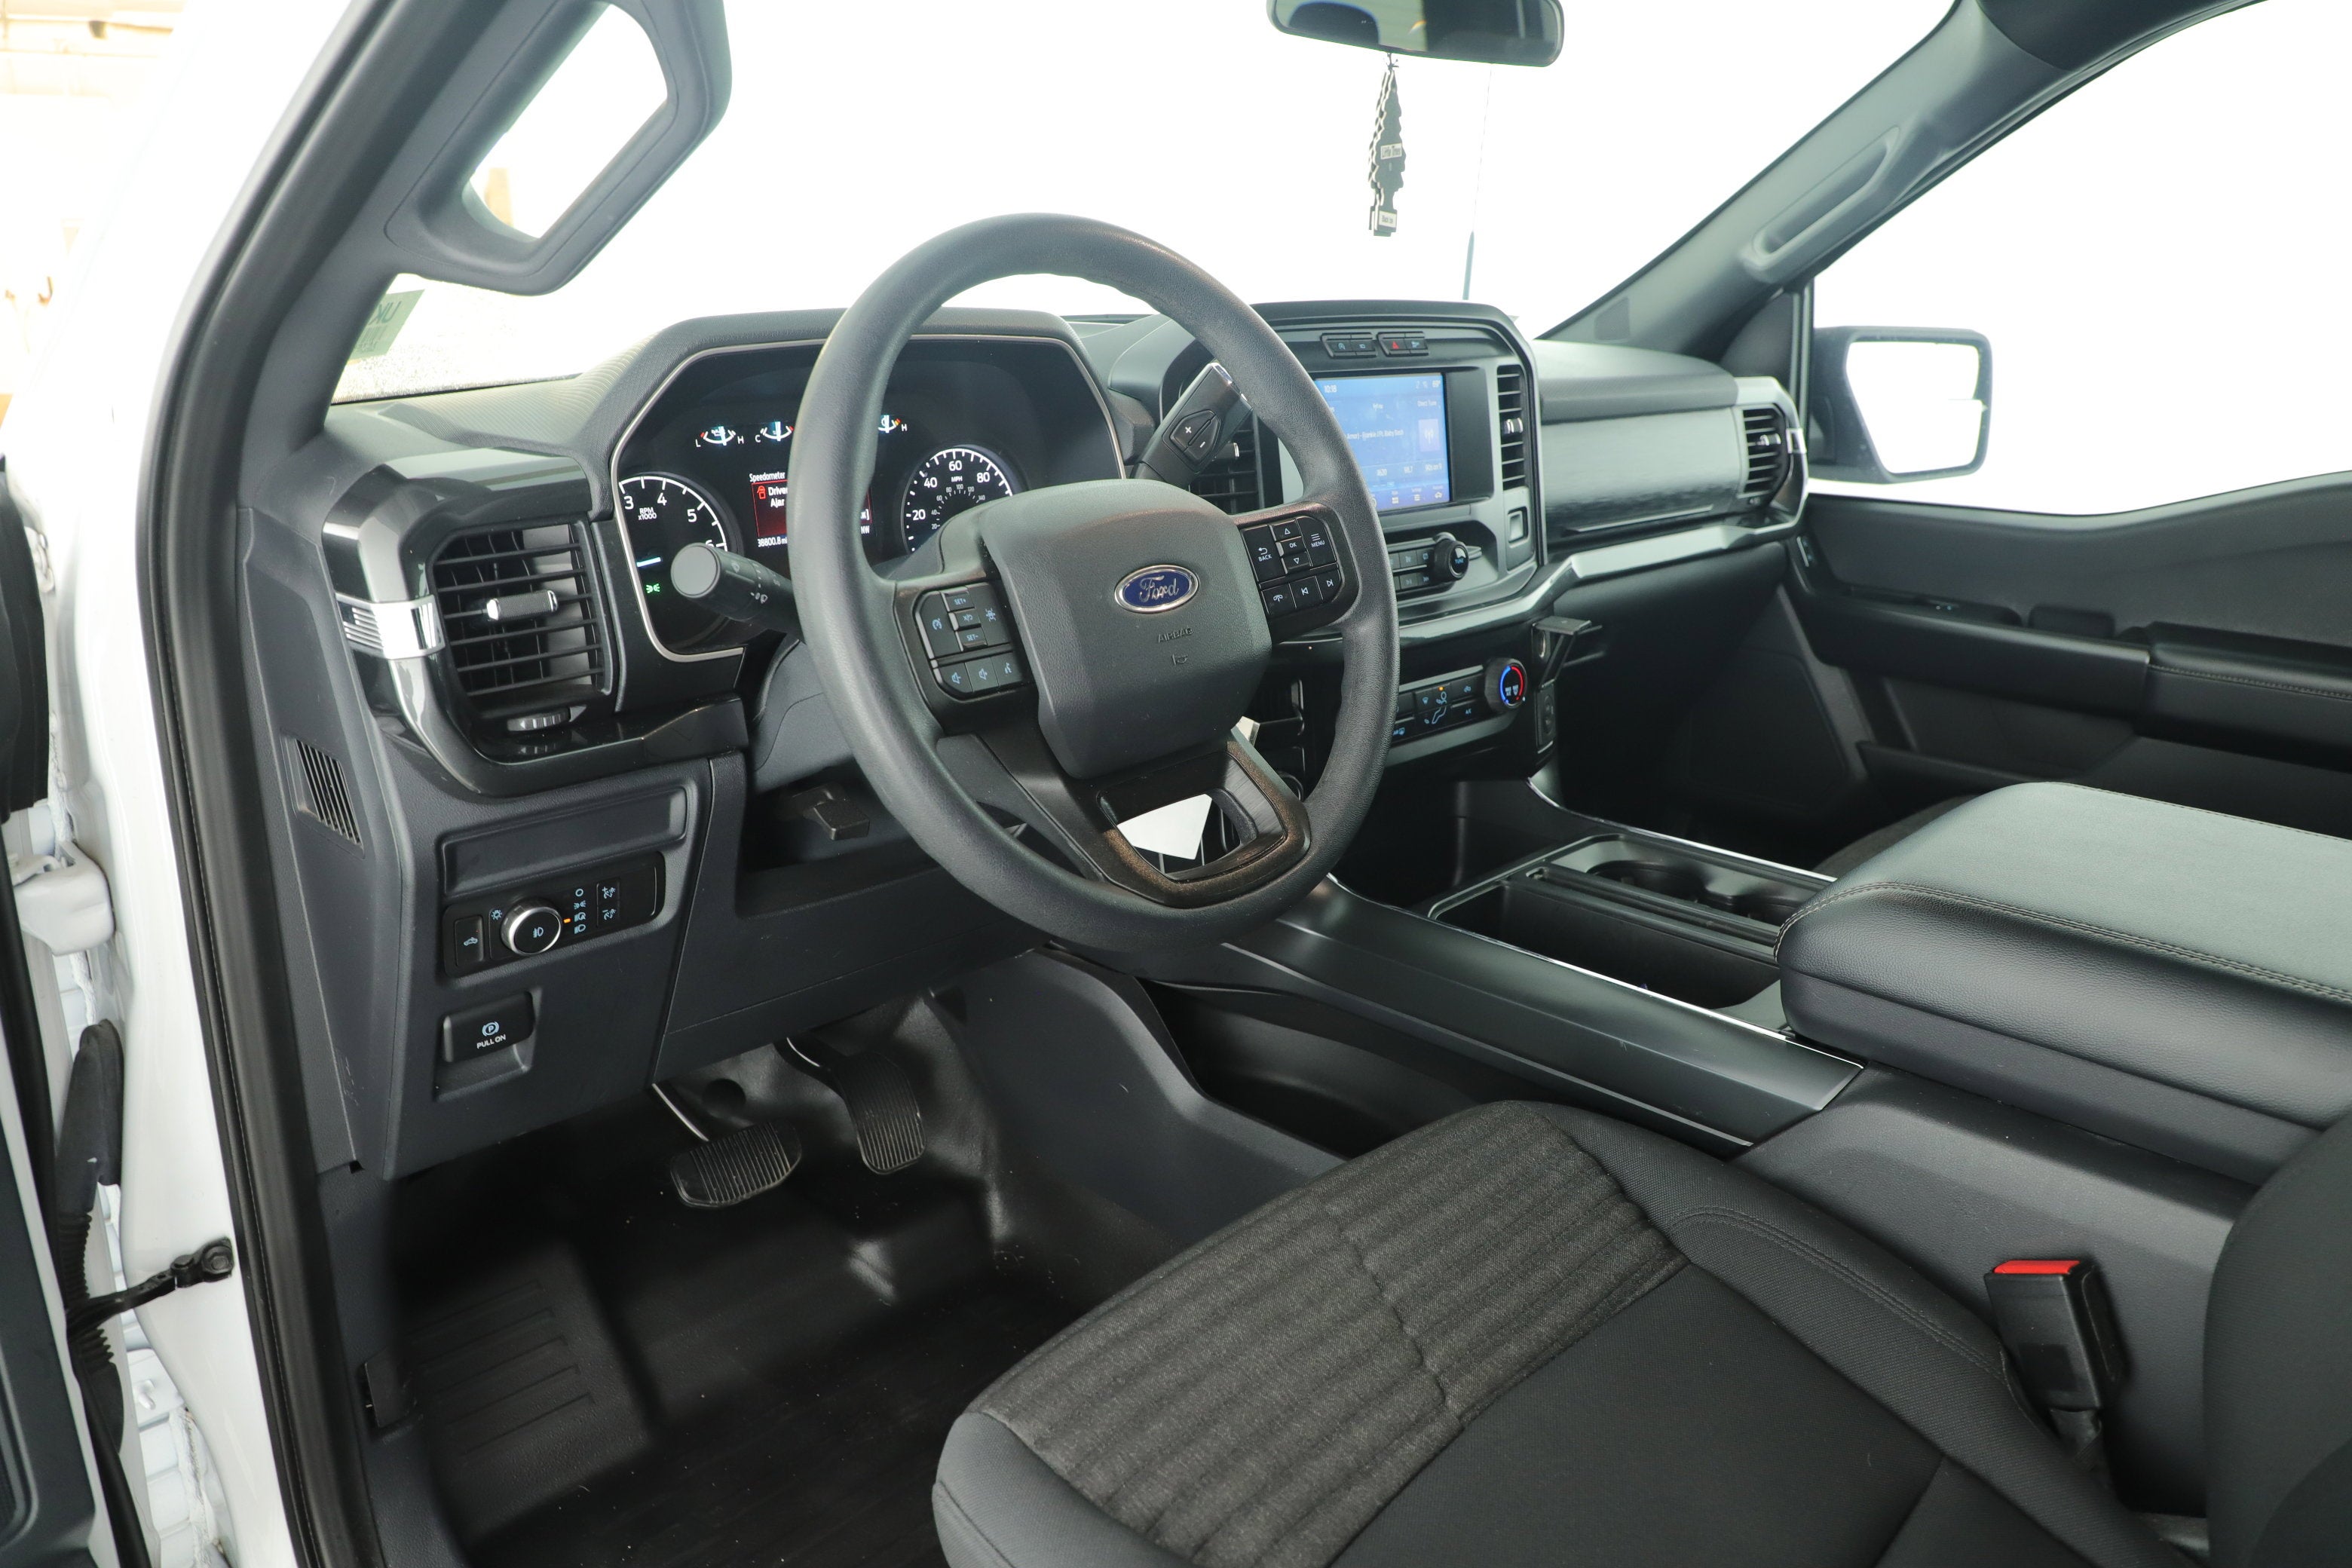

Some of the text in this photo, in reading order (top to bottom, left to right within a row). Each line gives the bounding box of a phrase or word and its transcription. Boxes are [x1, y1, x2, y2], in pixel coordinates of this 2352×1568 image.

[901, 424, 908, 432] H
[695, 439, 701, 448] L
[737, 436, 744, 444] H
[755, 435, 761, 443] C
[948, 460, 963, 471] 60
[749, 471, 786, 482] Speedometer
[976, 472, 991, 483] 80
[923, 477, 938, 488] 40
[623, 495, 634, 510] 3
[657, 492, 667, 506] 4
[770, 498, 785, 509] Ajar
[687, 508, 697, 522] 5
[912, 509, 926, 521] 20
[1311, 540, 1325, 548] MENU
[1258, 554, 1272, 562] BACK
[1138, 574, 1180, 603] Ford
[476, 1034, 507, 1049] PULL ON
